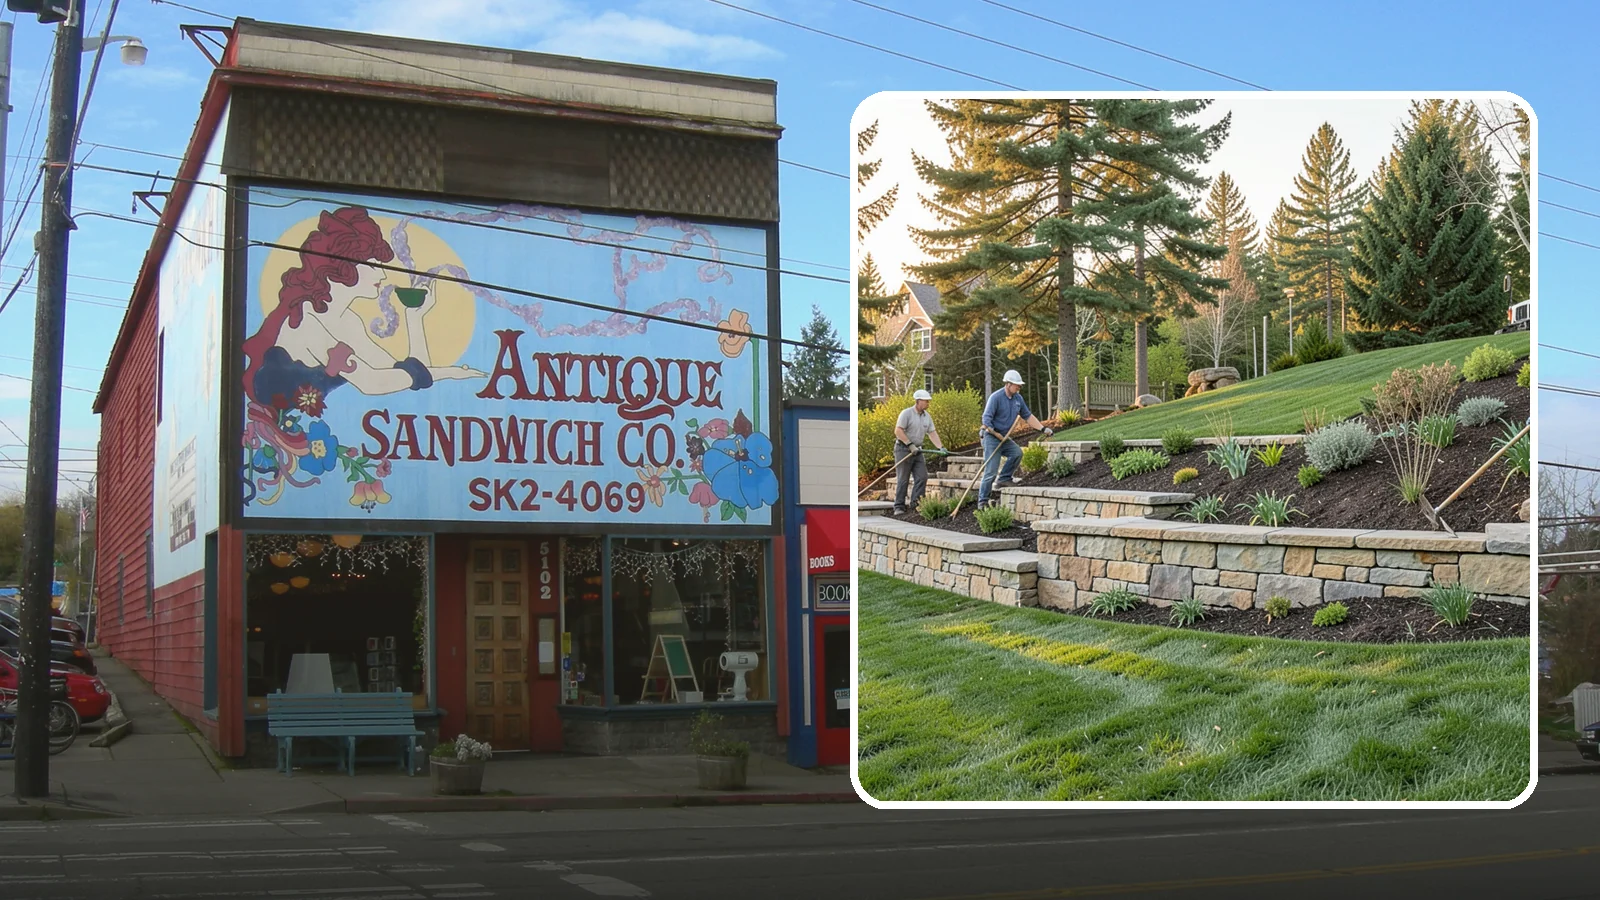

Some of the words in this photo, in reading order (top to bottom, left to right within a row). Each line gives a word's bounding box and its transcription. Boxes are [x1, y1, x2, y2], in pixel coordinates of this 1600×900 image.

[476, 329, 723, 420] ANTIQUE
[361, 409, 604, 467] SANDWICH
[618, 421, 685, 469] CO.
[468, 478, 645, 512] SK2-4069
[540, 542, 551, 599] 5102
[810, 555, 835, 569] BOOKS
